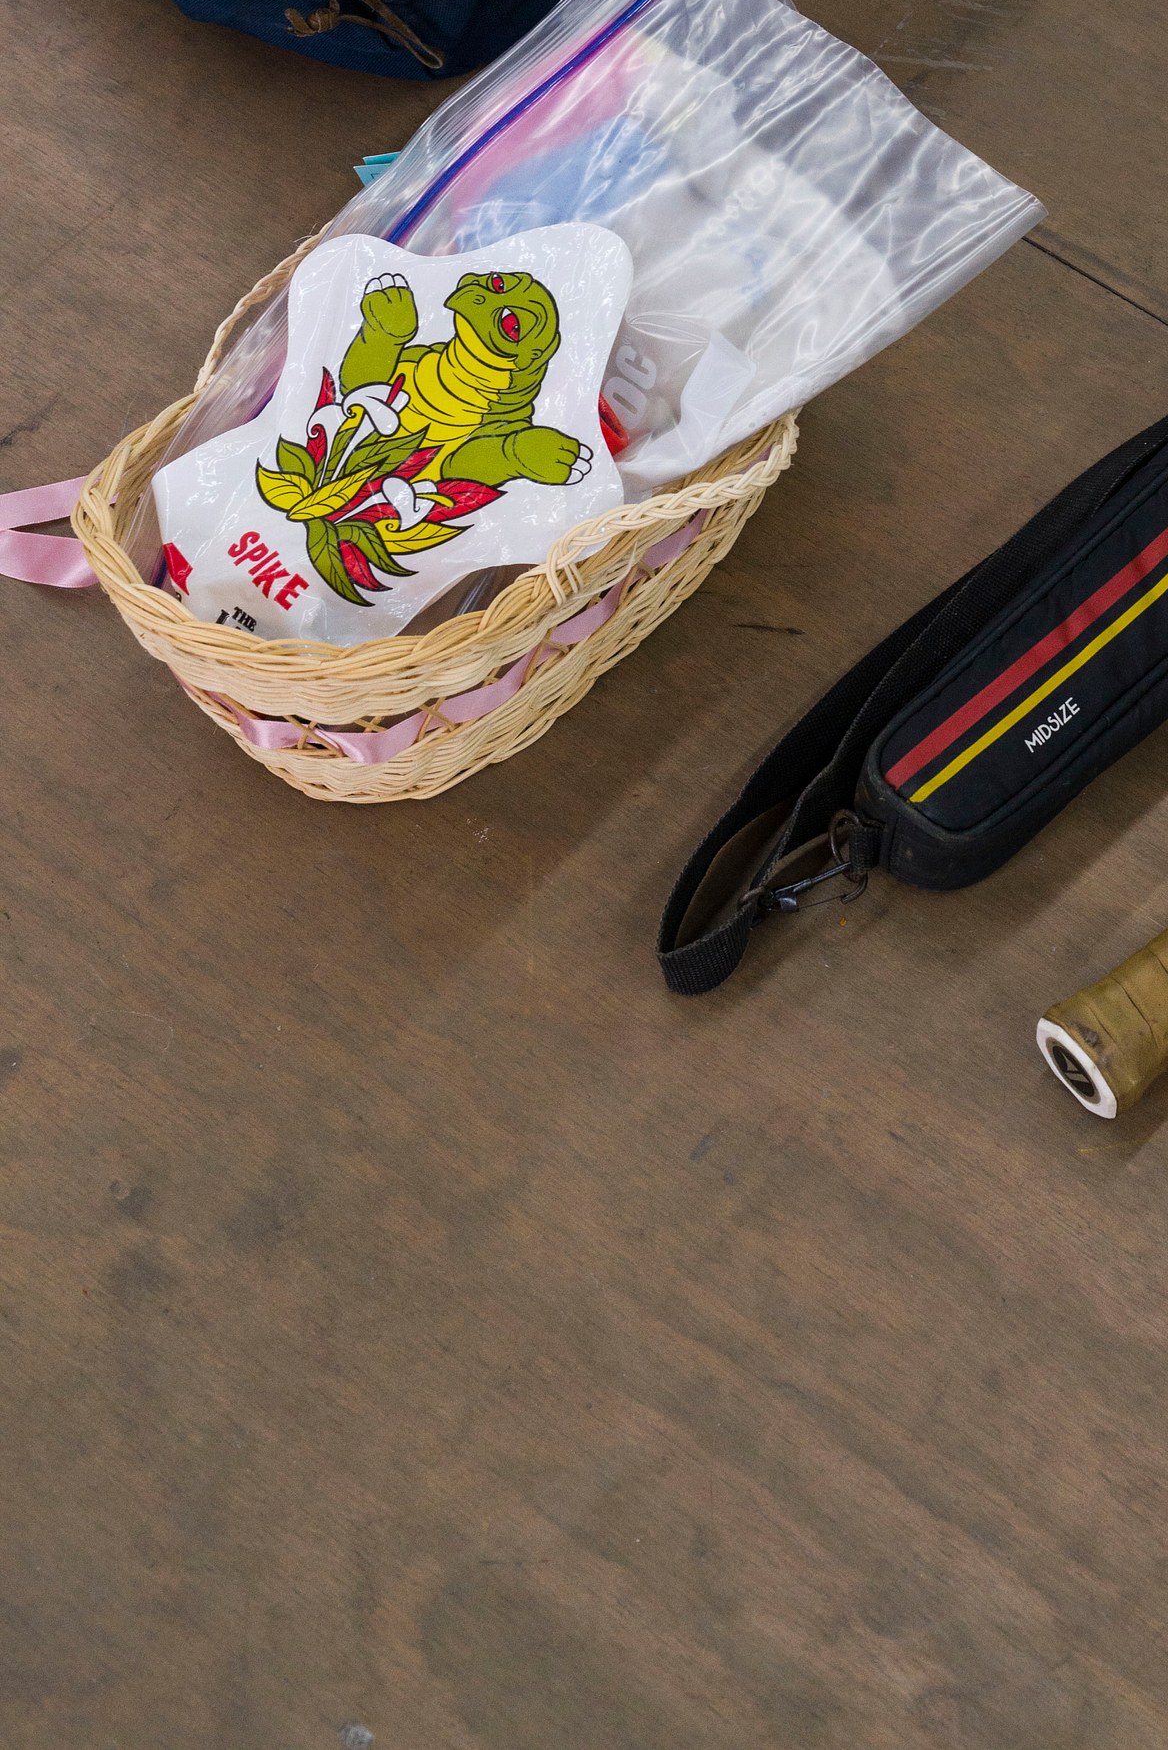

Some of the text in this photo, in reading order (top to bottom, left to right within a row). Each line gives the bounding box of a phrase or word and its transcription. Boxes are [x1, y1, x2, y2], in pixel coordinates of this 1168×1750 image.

[227, 530, 310, 611] SPIKE
[230, 606, 257, 632] THE
[1024, 696, 1081, 753] MIDSIZE
